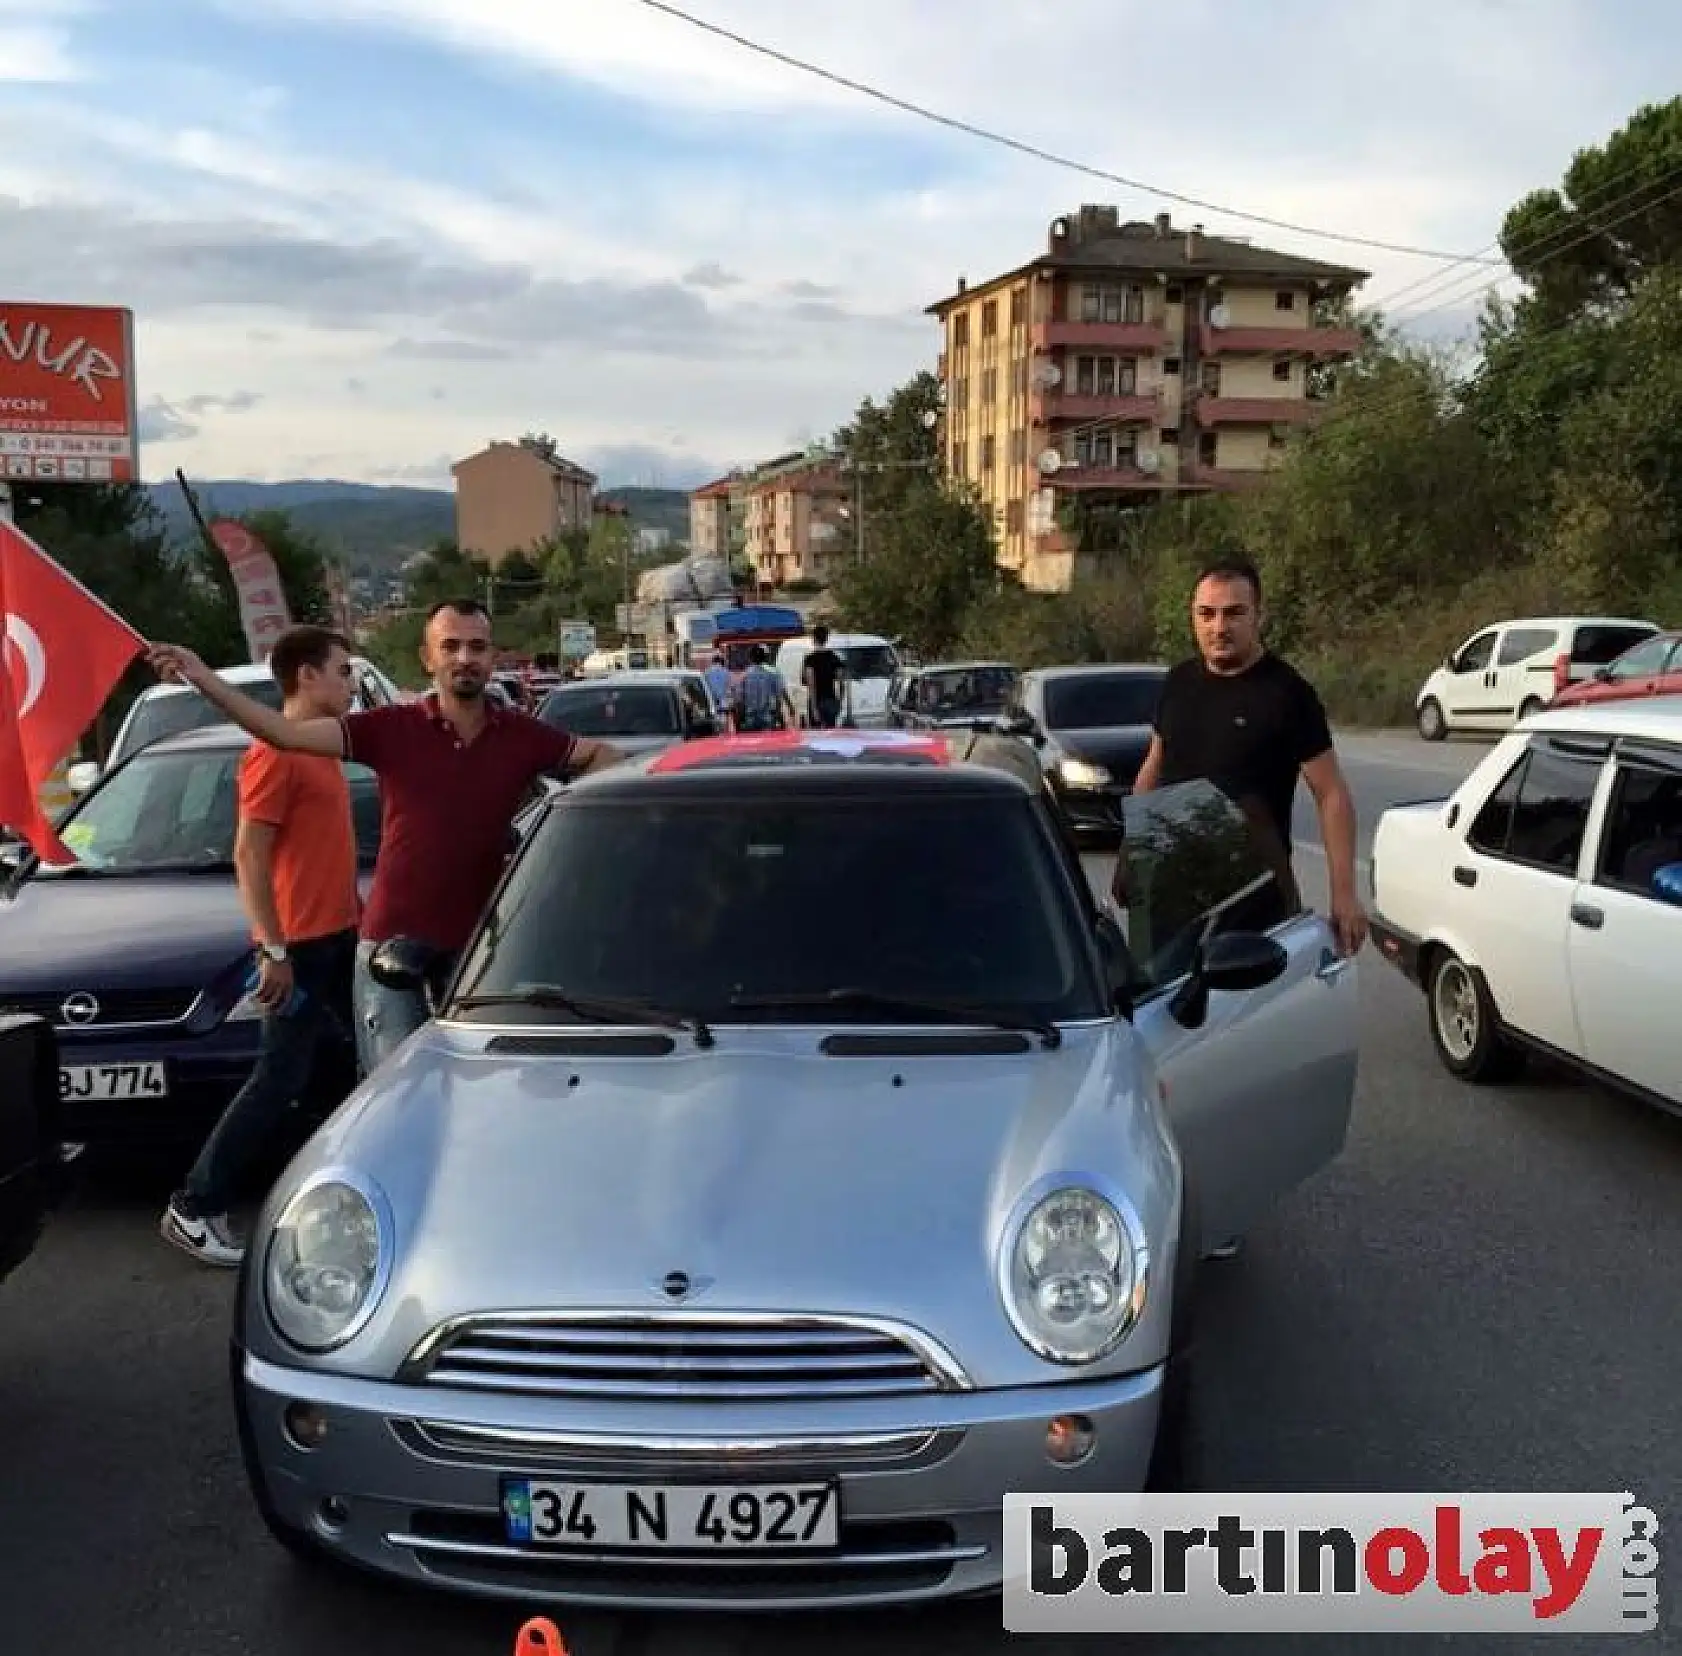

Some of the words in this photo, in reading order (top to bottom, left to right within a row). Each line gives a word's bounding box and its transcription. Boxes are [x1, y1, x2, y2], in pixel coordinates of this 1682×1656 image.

[101, 1065, 162, 1095] 774
[531, 1489, 597, 1540] 34
[626, 1491, 668, 1541] N
[695, 1490, 829, 1543] 4927
